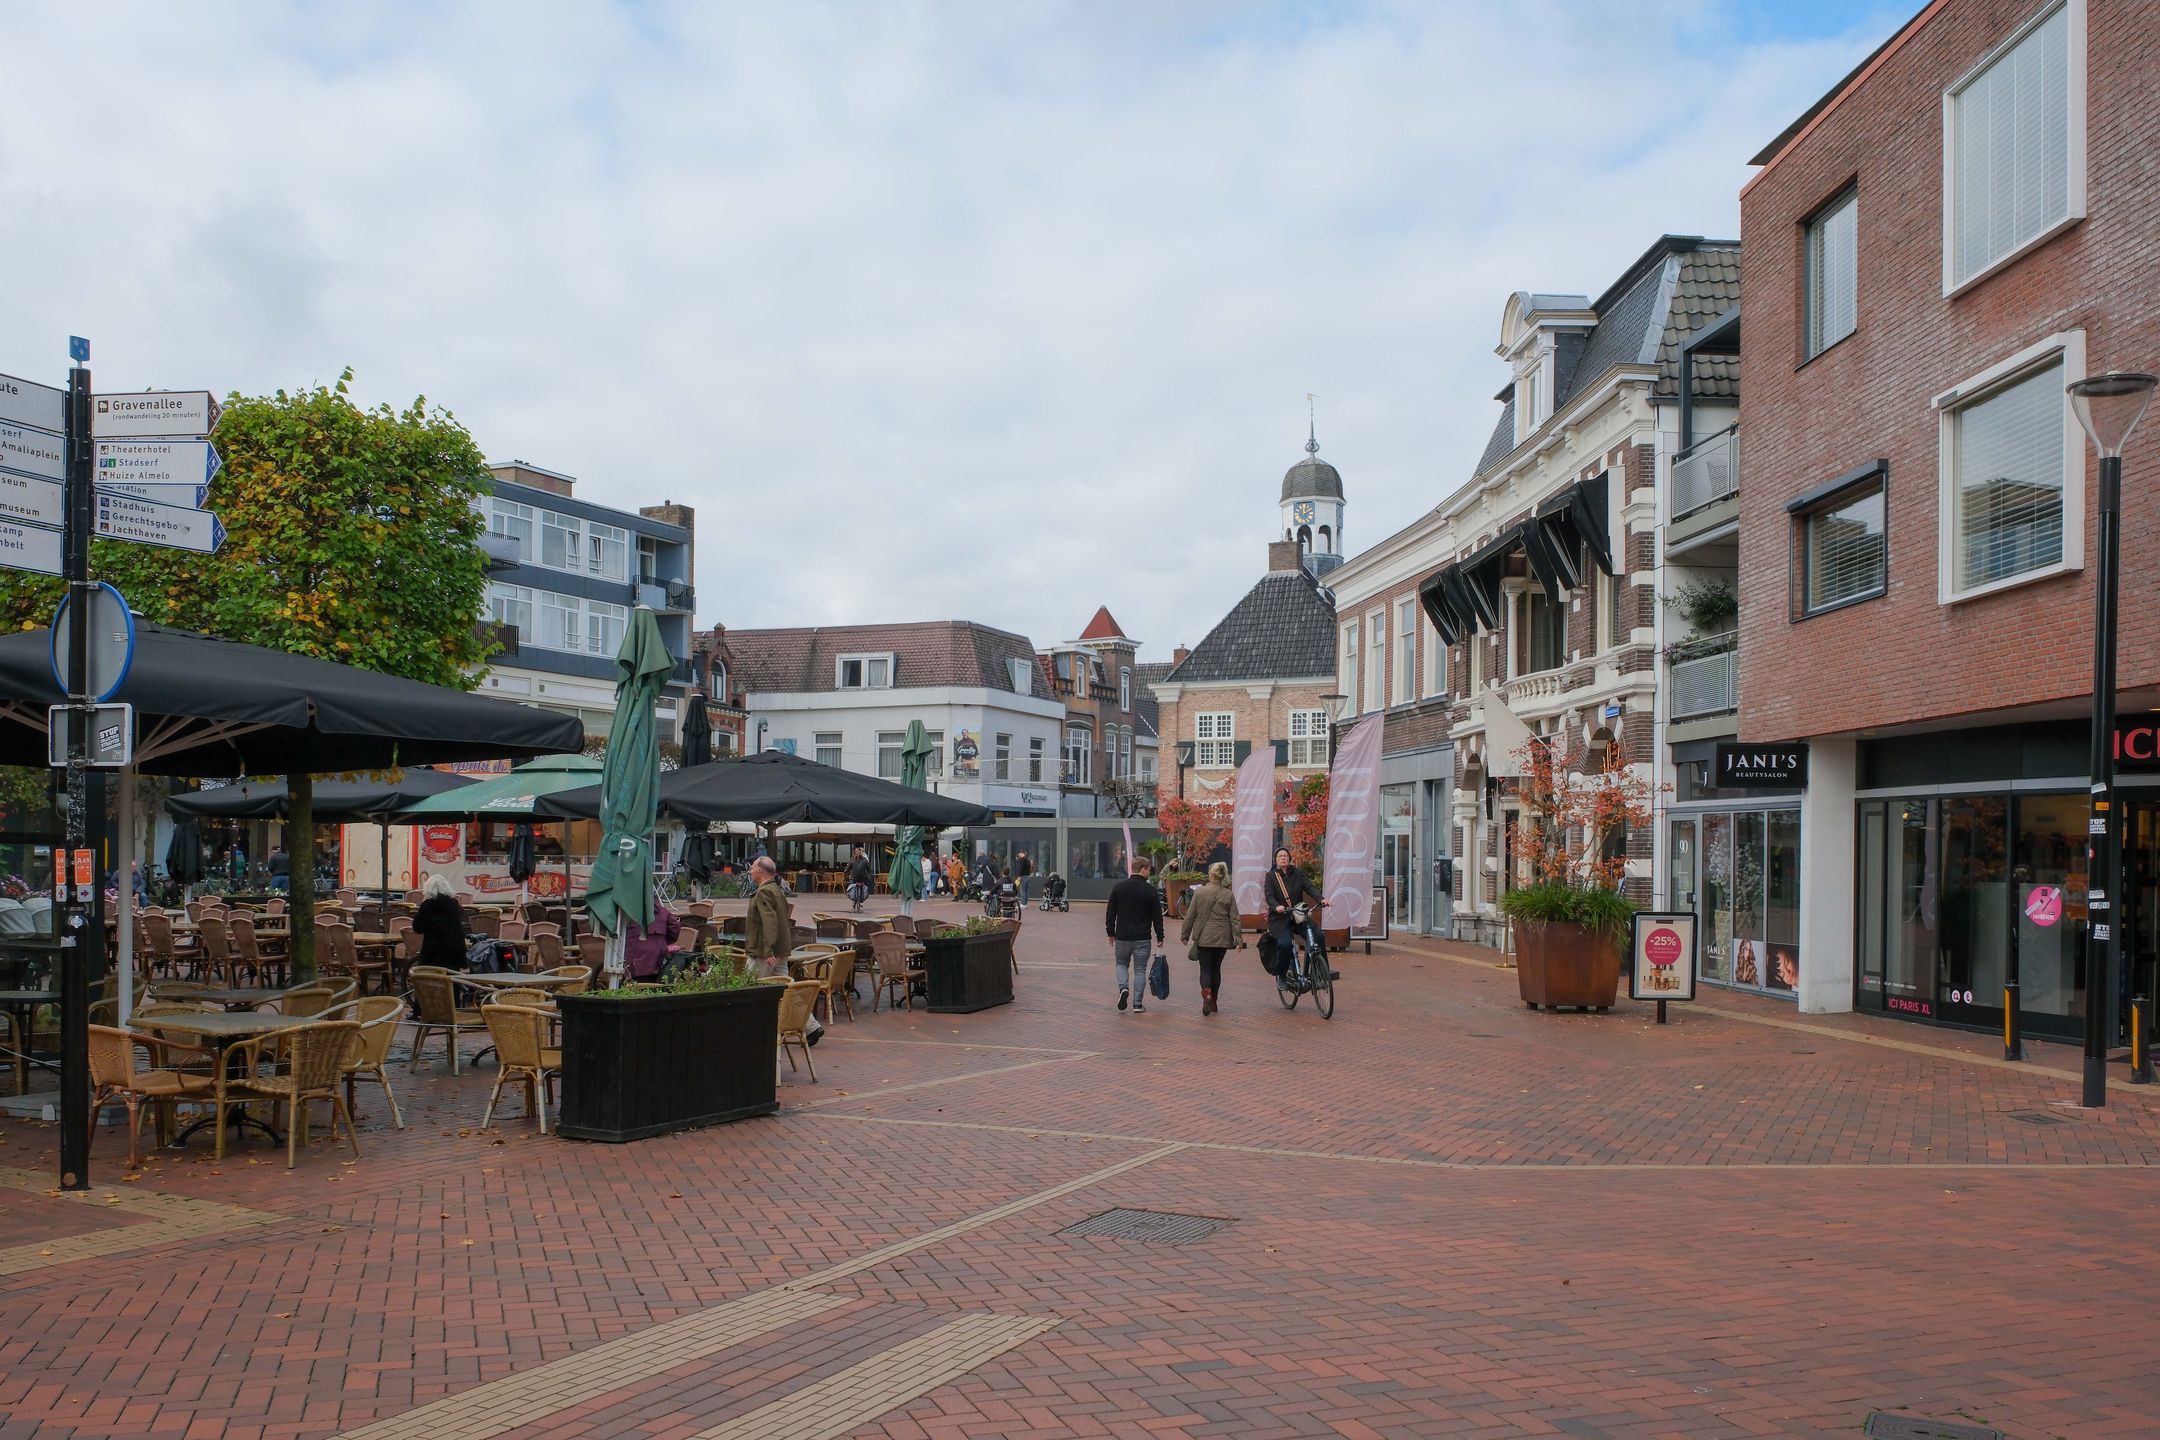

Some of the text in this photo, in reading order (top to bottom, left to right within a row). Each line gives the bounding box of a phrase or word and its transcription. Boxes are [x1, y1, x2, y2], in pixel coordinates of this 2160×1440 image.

[112, 398, 183, 411] Gravenallee
[172, 411, 201, 419] minuten)
[1, 440, 60, 461] Amaliaplein
[111, 445, 171, 454] Theaterhotel
[119, 458, 159, 467] Stadserf
[110, 471, 170, 480] Huize Almelo
[112, 499, 155, 514] Stadhuis
[112, 512, 191, 532] Gerechtsgebow
[112, 525, 167, 540] Jachthaven
[99, 725, 119, 739] STOP
[1726, 754, 1797, 772] JANI'S
[1328, 767, 1373, 920] mate
[1679, 839, 1689, 854] 90
[1649, 936, 1677, 946] -25%
[1888, 997, 1931, 1015] ICI PARIS XL
